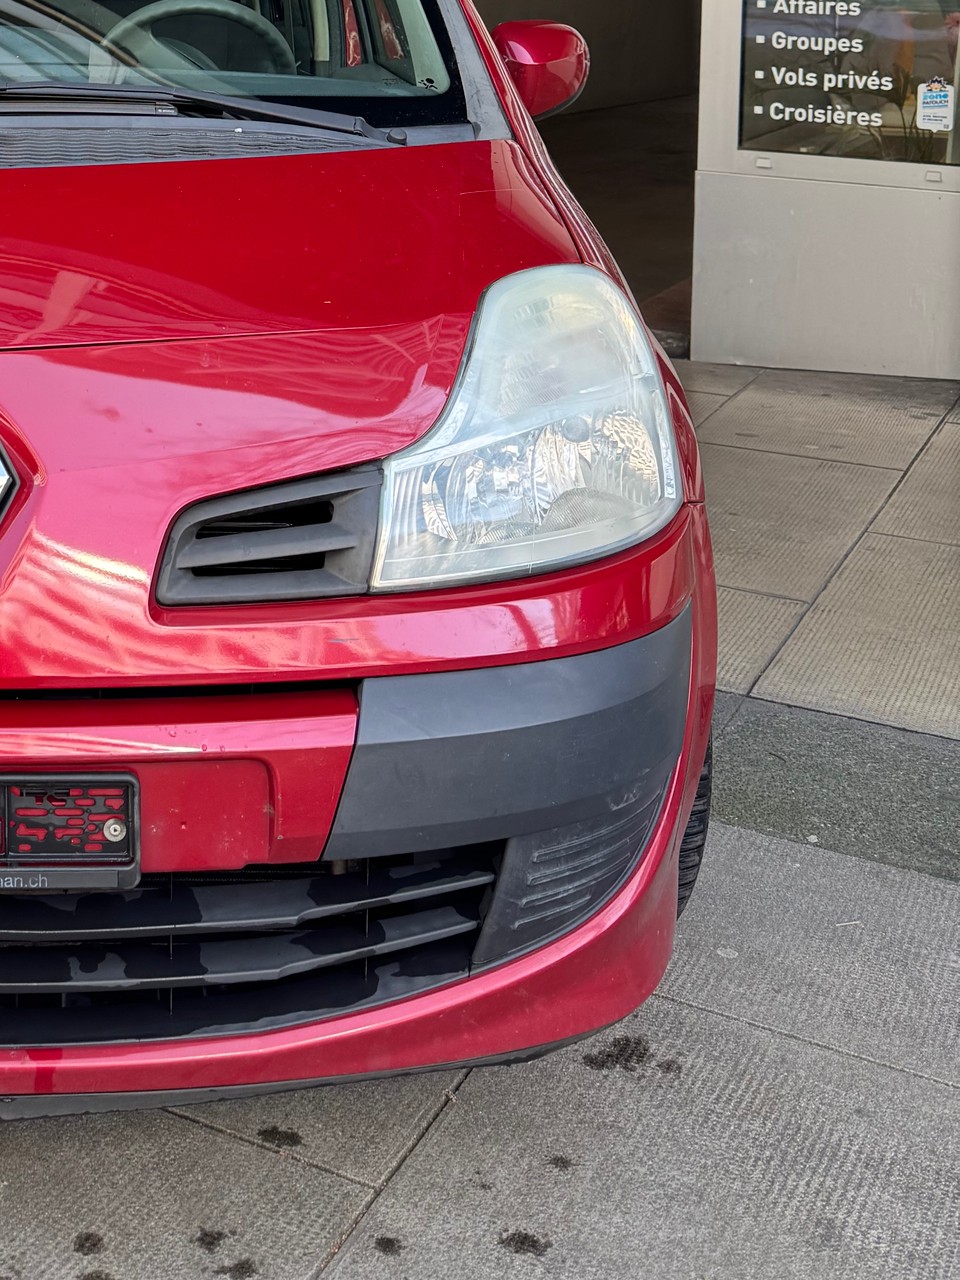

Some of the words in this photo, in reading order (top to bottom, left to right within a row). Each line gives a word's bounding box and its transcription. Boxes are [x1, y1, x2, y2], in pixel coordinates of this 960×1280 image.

[771, 31, 864, 55] Groupes
[771, 67, 818, 87] Vols
[823, 71, 894, 91] privés
[769, 102, 883, 127] Croisières
